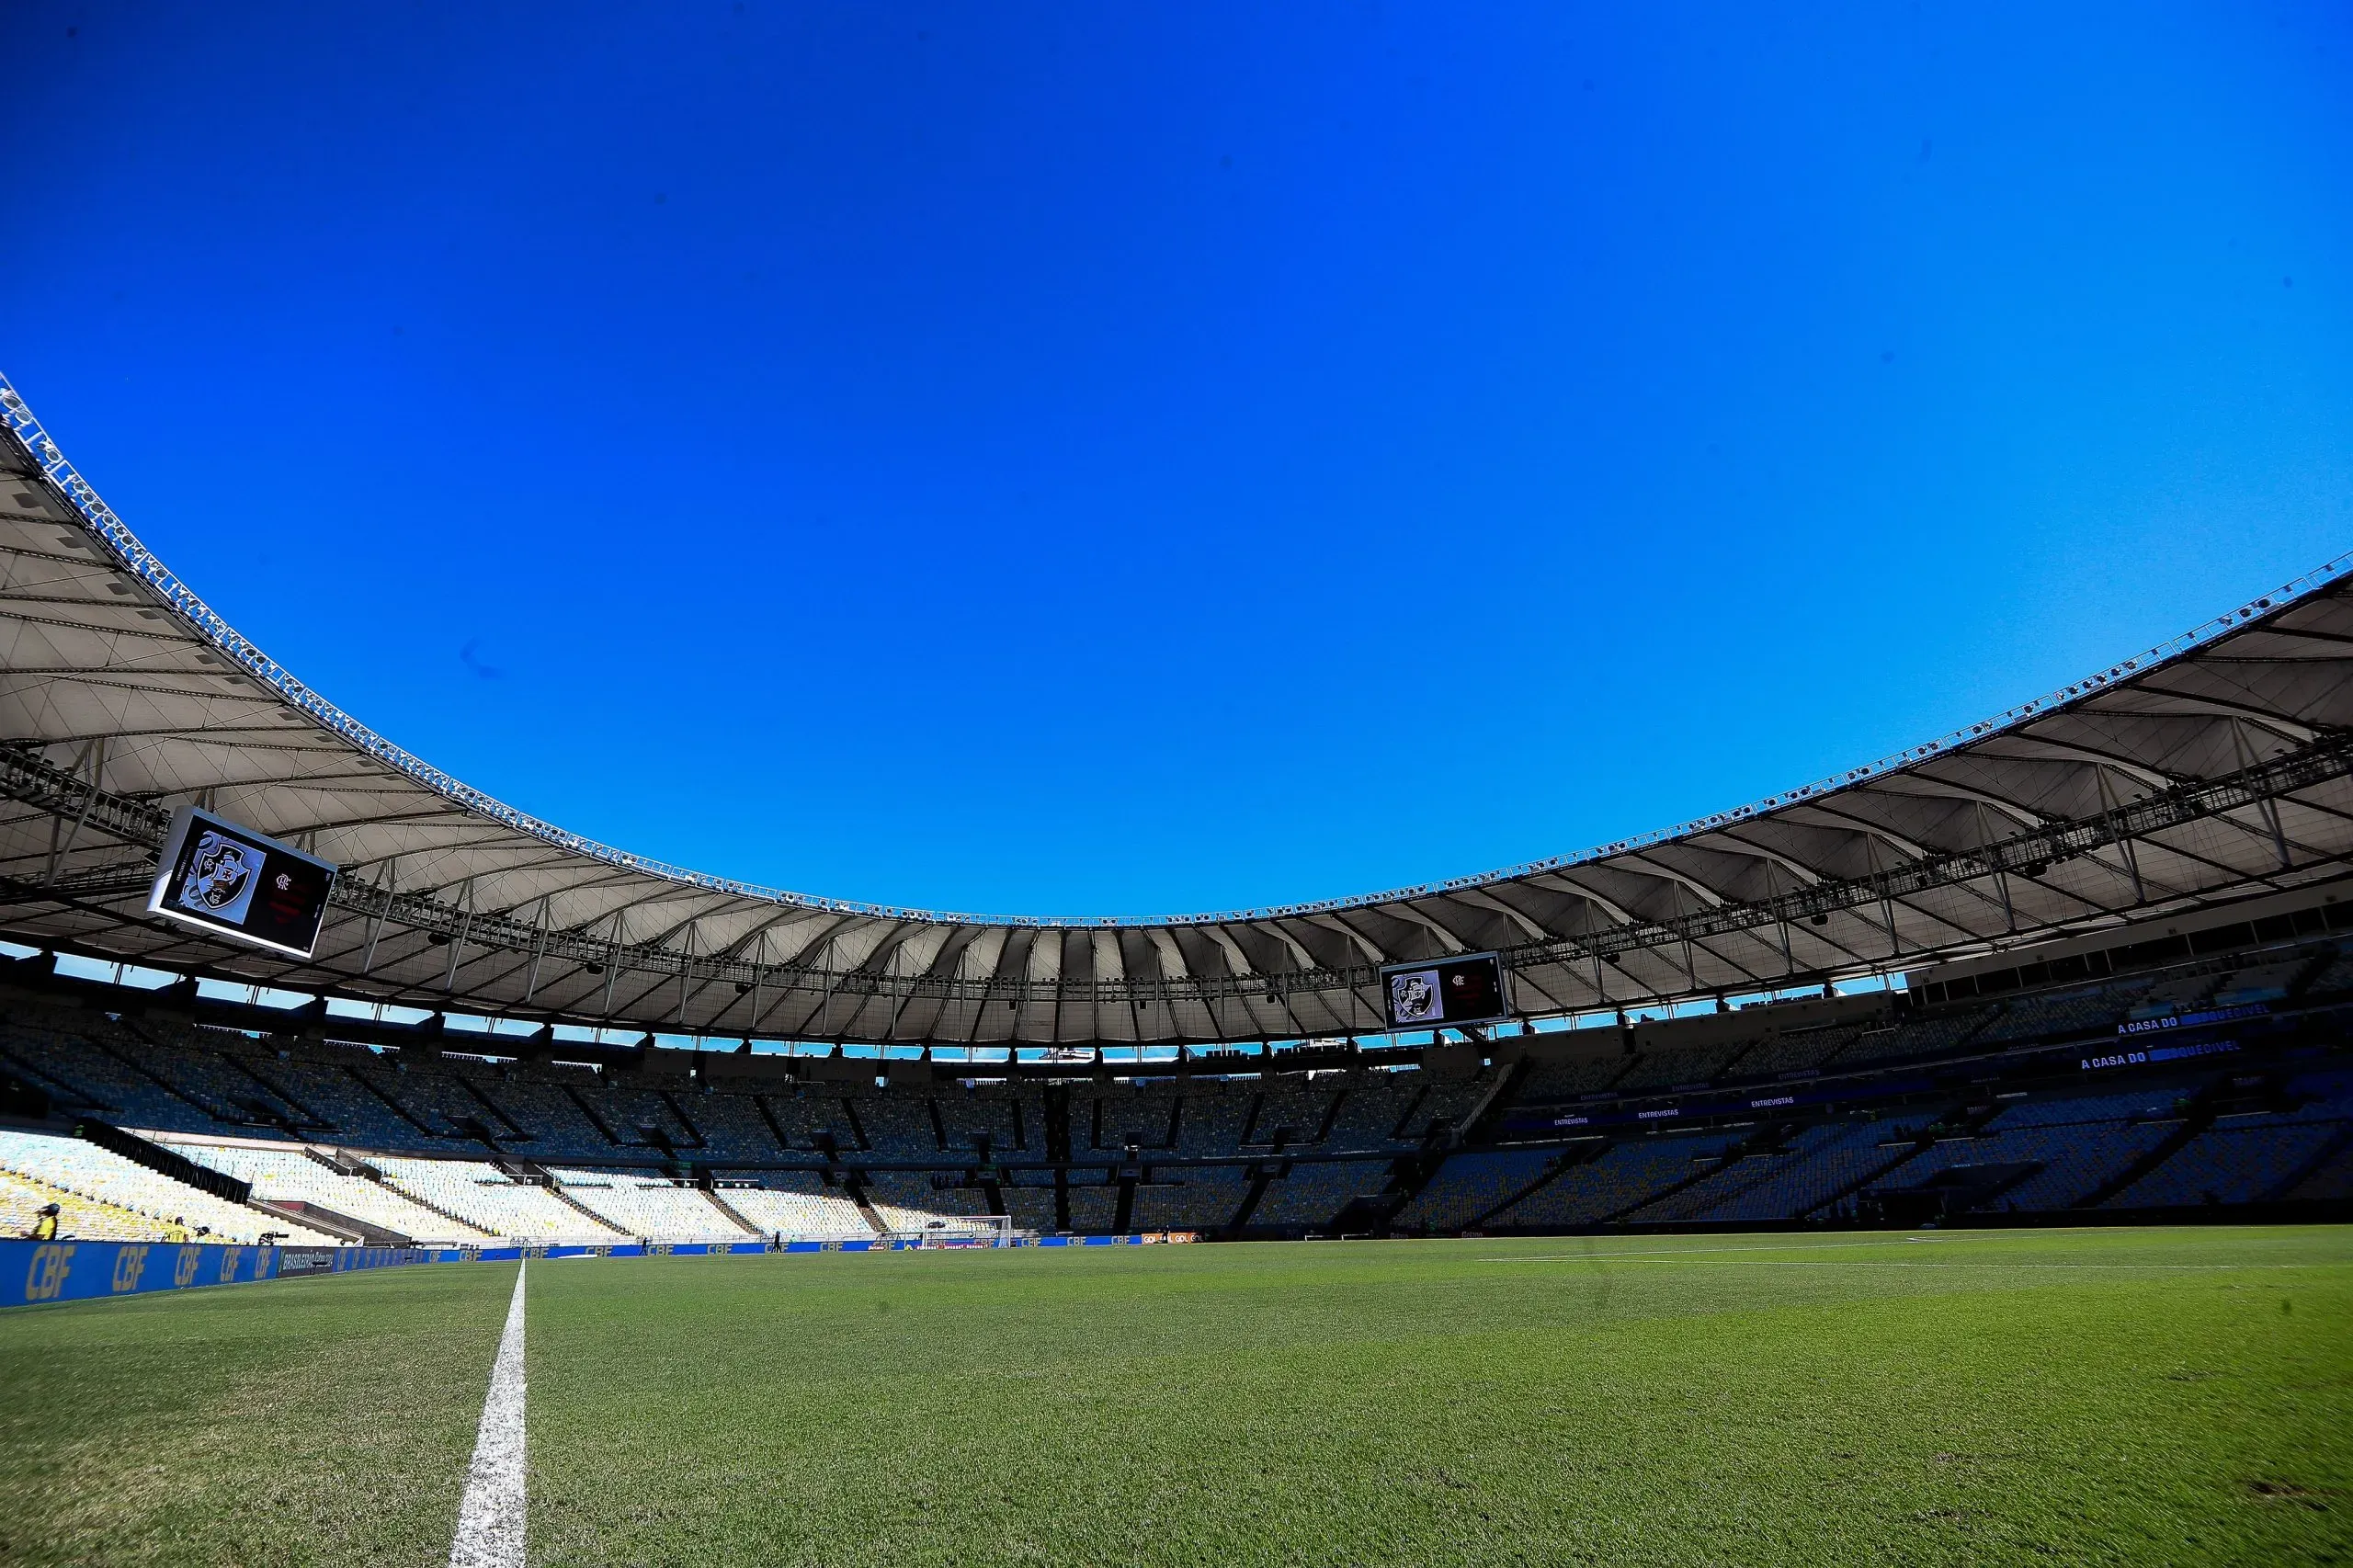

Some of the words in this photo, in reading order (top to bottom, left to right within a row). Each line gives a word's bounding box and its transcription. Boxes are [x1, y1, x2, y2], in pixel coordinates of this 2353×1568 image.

[2118, 1023, 2127, 1035] A
[2129, 1017, 2160, 1033] CASA
[2161, 1016, 2178, 1028] DO
[2081, 1058, 2091, 1071] A
[2093, 1052, 2126, 1069] CASA
[2128, 1051, 2146, 1064] DO
[1750, 1096, 1794, 1108] ENTREVISTAS
[1638, 1108, 1679, 1119] ENTREVISTAS
[1554, 1117, 1589, 1126] ENTREVISTAS
[1066, 1236, 1087, 1246] CBF
[1110, 1235, 1131, 1245] CBF
[1175, 1234, 1188, 1243] GOL
[1190, 1234, 1204, 1243] GOL
[647, 1245, 674, 1256] CBF
[707, 1244, 733, 1255] CBF
[765, 1243, 790, 1254] CF
[819, 1242, 844, 1253] CBF
[174, 1245, 203, 1286] CBF
[220, 1247, 242, 1282] CBF
[255, 1247, 273, 1278] CBF
[26, 1244, 77, 1301] CBF
[112, 1245, 150, 1292] CBF
